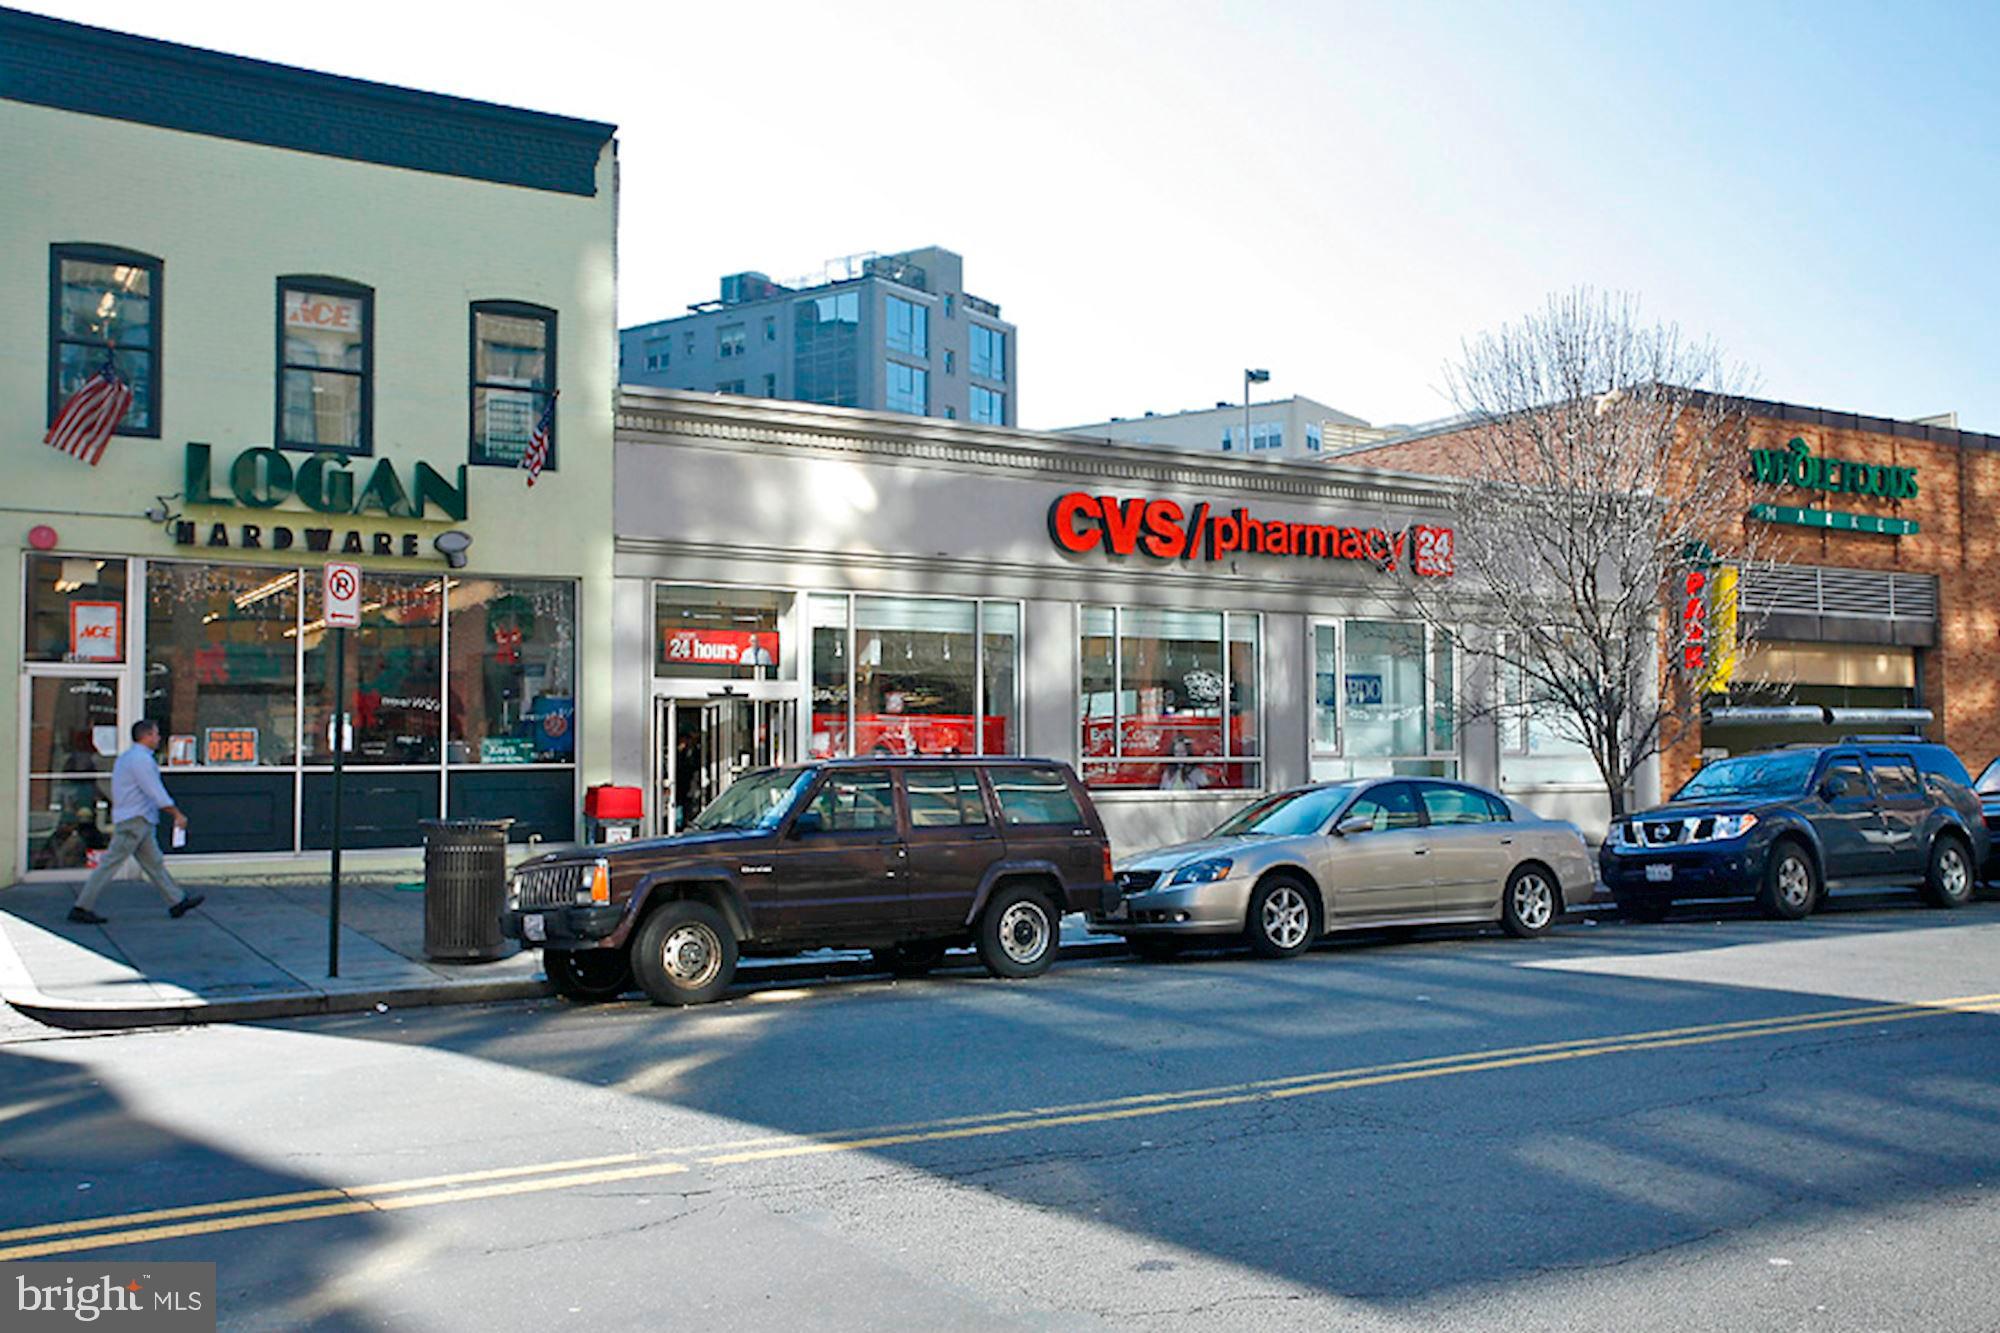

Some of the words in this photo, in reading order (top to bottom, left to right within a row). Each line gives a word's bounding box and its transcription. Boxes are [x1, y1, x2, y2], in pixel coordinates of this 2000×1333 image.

[288, 301, 353, 328] ACE
[184, 442, 468, 521] LOGAN
[1048, 491, 1406, 573] CVS/pharmacy
[1765, 506, 1910, 535] MARKET
[175, 521, 418, 556] HARDWARE
[1419, 530, 1450, 559] 24
[80, 623, 113, 639] ACE
[670, 638, 691, 659] 24
[693, 638, 738, 660] hours
[208, 740, 255, 762] OPEN
